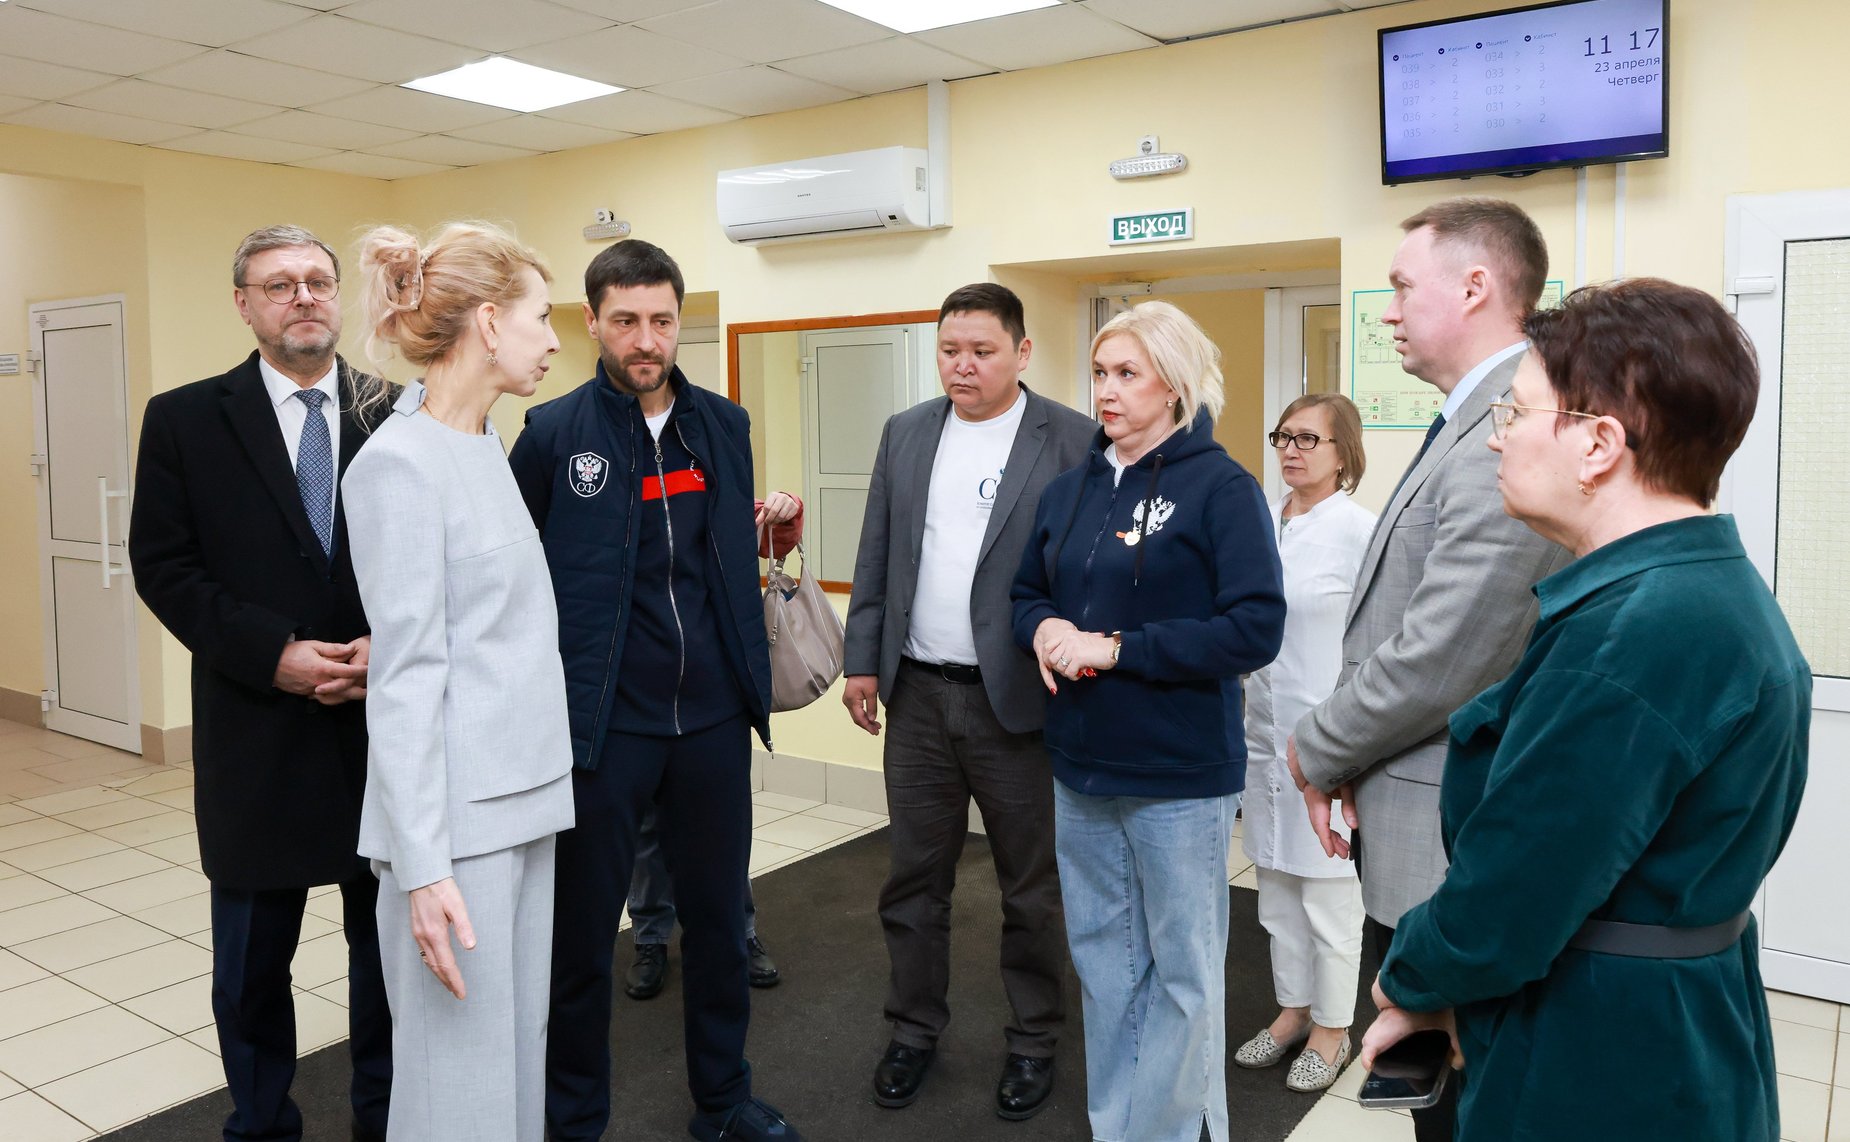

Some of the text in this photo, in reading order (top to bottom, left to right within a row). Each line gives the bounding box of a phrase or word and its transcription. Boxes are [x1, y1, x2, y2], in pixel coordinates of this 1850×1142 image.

[1584, 28, 1660, 57] 11 17
[1485, 45, 1545, 62] 034 2
[1401, 57, 1458, 74] 039 2
[1485, 62, 1545, 79] 033 3
[1594, 57, 1660, 73] 23 апреля
[1402, 74, 1458, 90] 038 2
[1485, 79, 1545, 96] 032 2
[1402, 95, 1420, 106] 037
[1485, 96, 1545, 112] 031 3
[1403, 111, 1421, 122] 036
[1486, 113, 1546, 129] 030 2
[1403, 127, 1421, 138] 035
[1118, 215, 1183, 236] ВЫХОД
[576, 481, 596, 494] СФ
